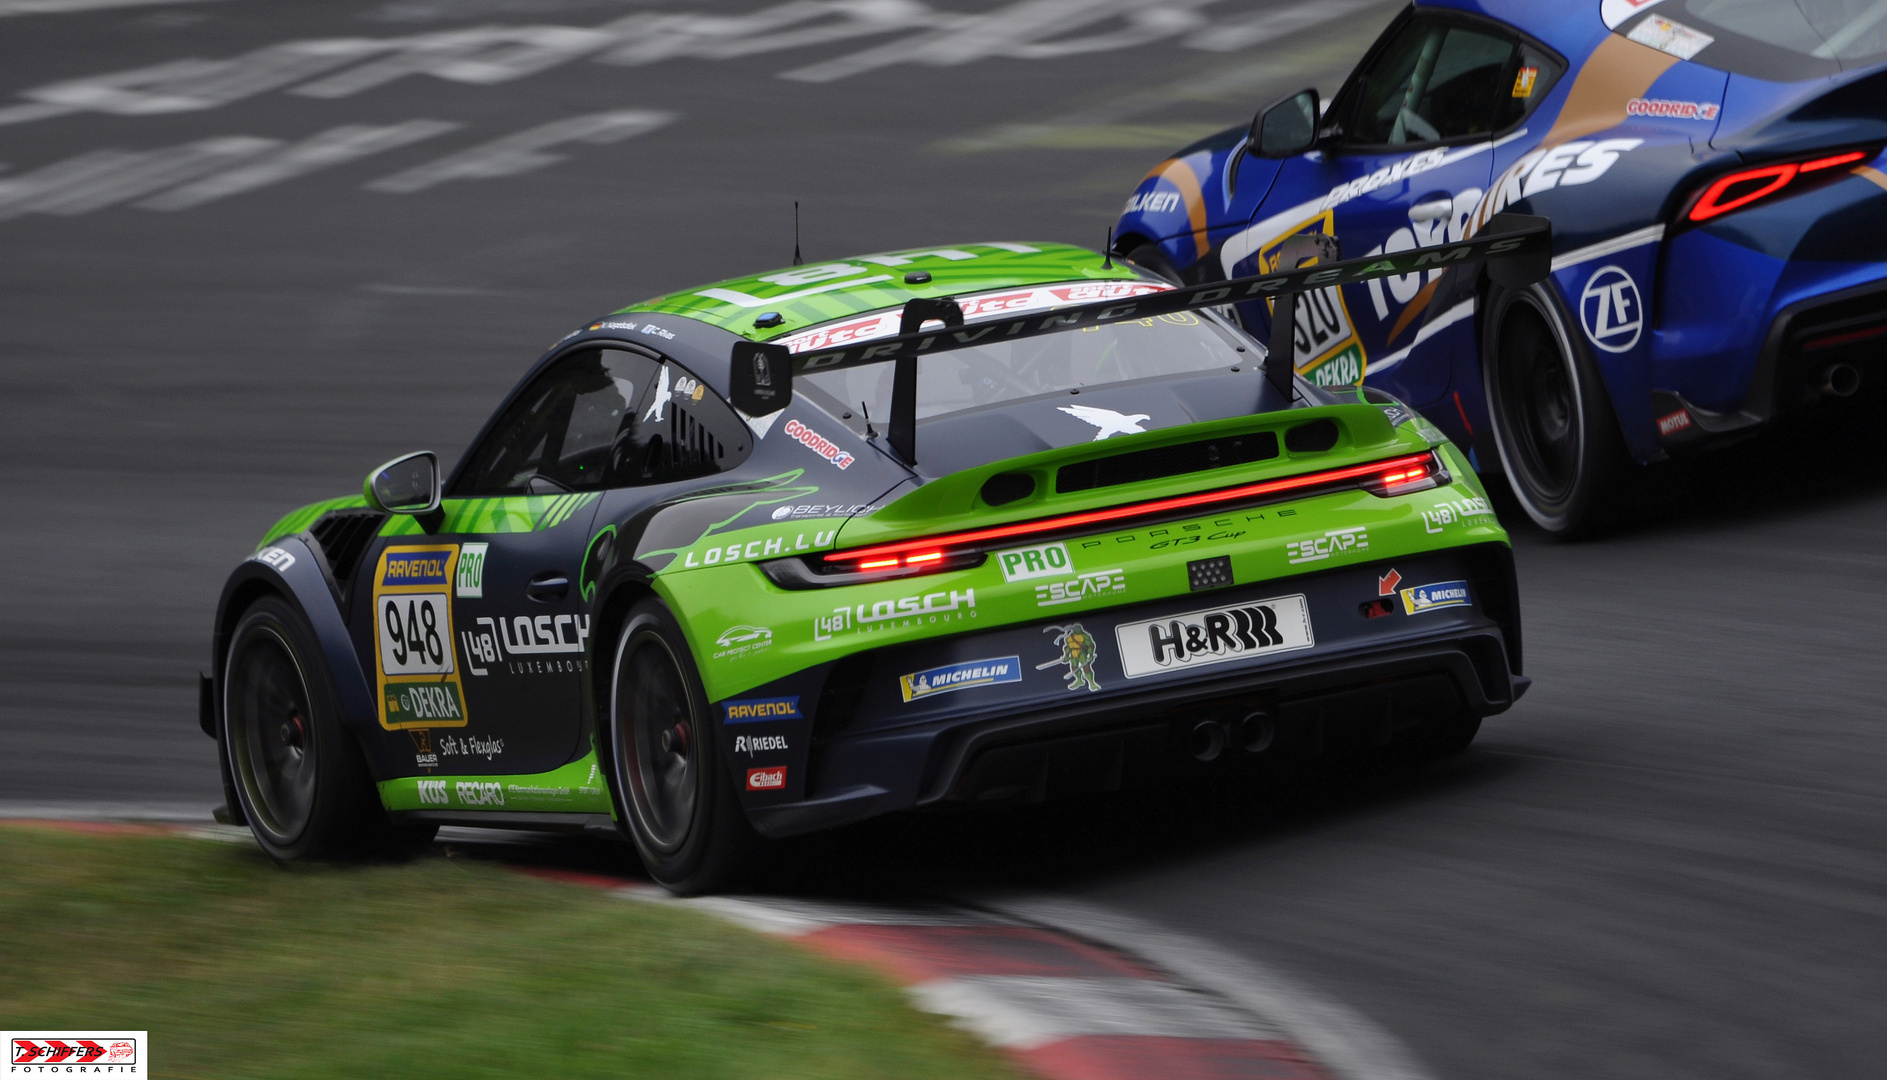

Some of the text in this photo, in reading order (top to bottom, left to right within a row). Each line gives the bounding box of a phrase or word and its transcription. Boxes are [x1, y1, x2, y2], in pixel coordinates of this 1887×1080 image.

[1627, 98, 1720, 120] GOODRIDGE
[1319, 146, 1449, 213] PROXES
[802, 302, 1137, 371] DRIVING
[1187, 236, 1527, 305] DREAMS
[1583, 277, 1642, 340] ZF
[1315, 349, 1360, 388] DEKRA
[1660, 411, 1690, 435] MOTUL
[784, 419, 855, 471] GOODRIDGE
[1081, 508, 1298, 550] PORSCHE
[1149, 530, 1247, 550] GT3 Cup
[684, 530, 835, 569] LOSCH.LU
[1286, 526, 1370, 565] ESCAPE
[387, 558, 444, 578] RAVENOL
[458, 551, 483, 588] PRO
[1001, 546, 1068, 577] PRO
[1034, 568, 1126, 607] ESCAPE
[1431, 587, 1467, 601] MICHELIN
[856, 587, 976, 624] LOSCH
[385, 600, 444, 666] 948
[499, 614, 591, 655] LOSCH
[857, 610, 978, 635] LUXEMBOURG
[713, 651, 726, 659] CAR
[727, 645, 751, 656] PROTECT
[752, 639, 773, 650] CENTER
[931, 664, 1009, 687] MICHELIN
[408, 686, 460, 718] DEKRA
[728, 702, 795, 719] RAVENOL
[416, 754, 438, 763] BAUER
[440, 735, 459, 756] Soft
[460, 738, 469, 755] &
[752, 735, 789, 751] RIEDEL
[456, 781, 505, 806] RECARO
[749, 770, 783, 788] Eibach
